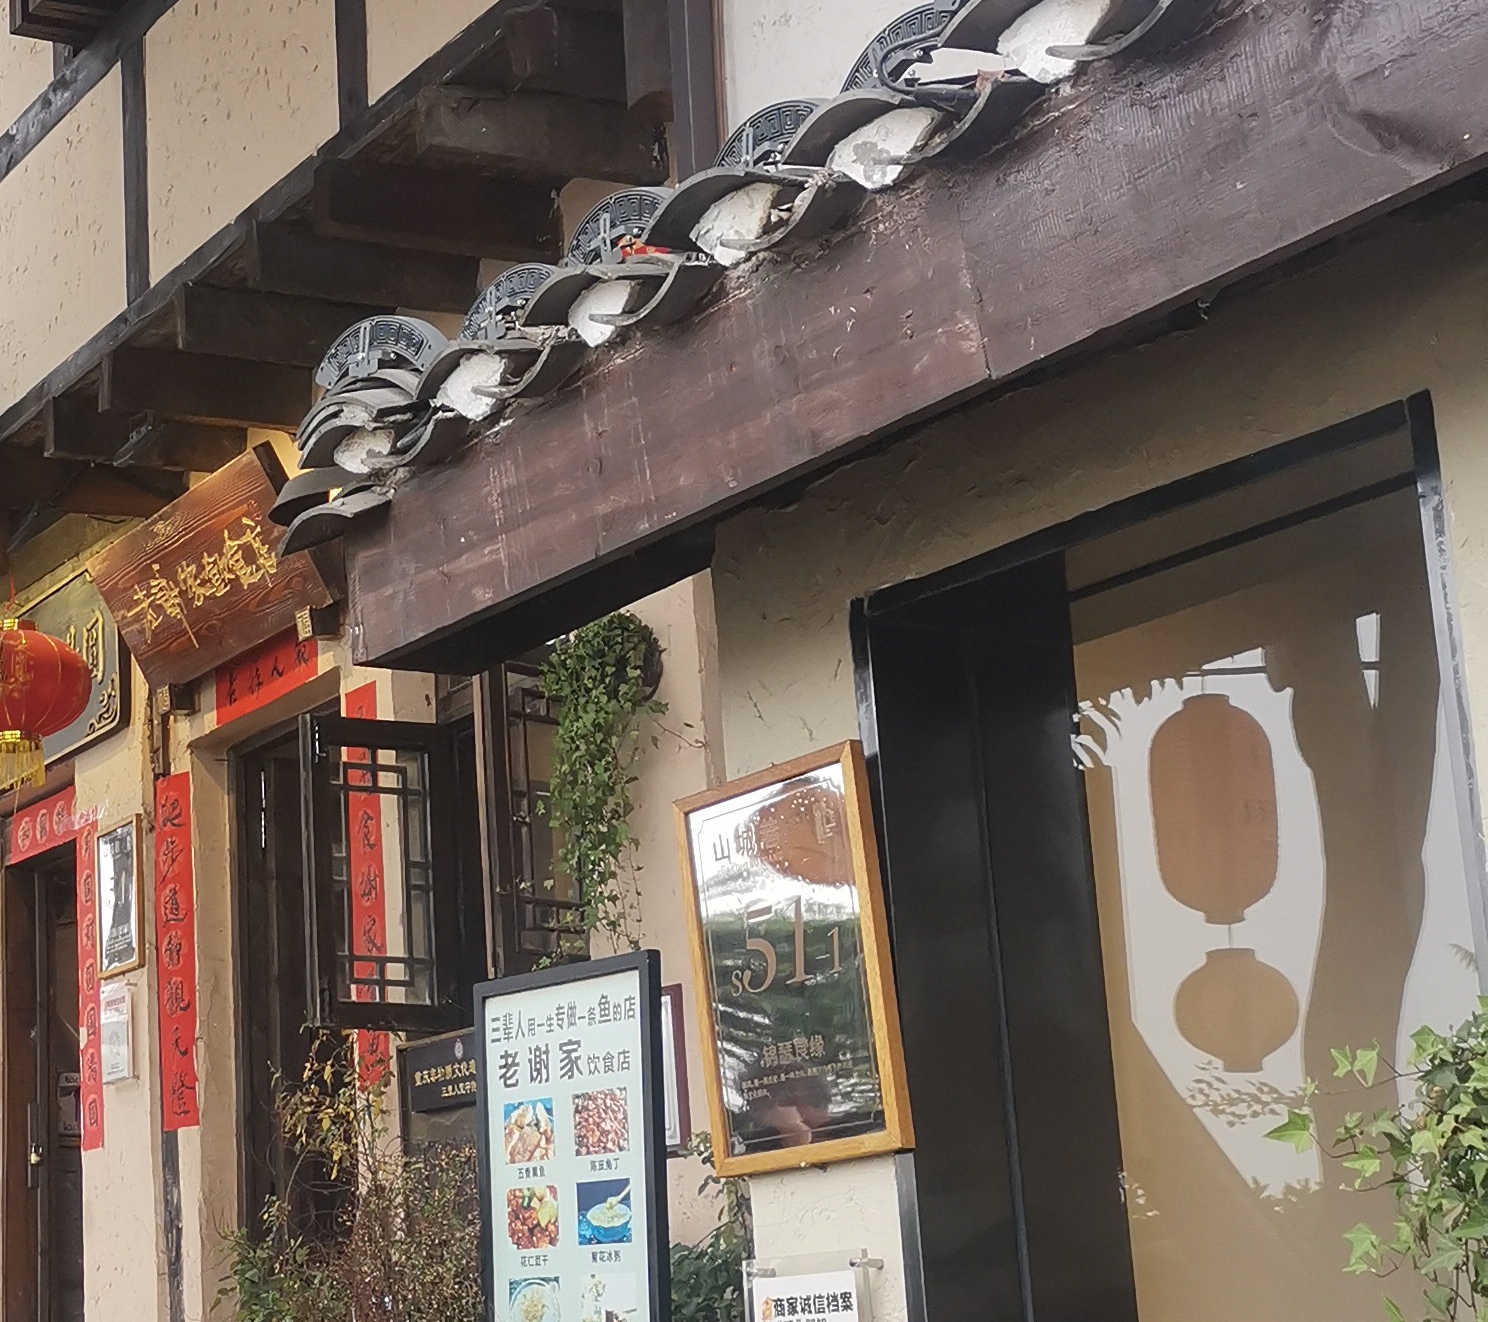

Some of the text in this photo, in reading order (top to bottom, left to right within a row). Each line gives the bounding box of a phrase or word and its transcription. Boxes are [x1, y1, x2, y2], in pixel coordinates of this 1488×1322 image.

[491, 993, 636, 1044] 三辈人用一生专做一条鱼的店
[498, 1038, 631, 1089] 老谢家饮食店
